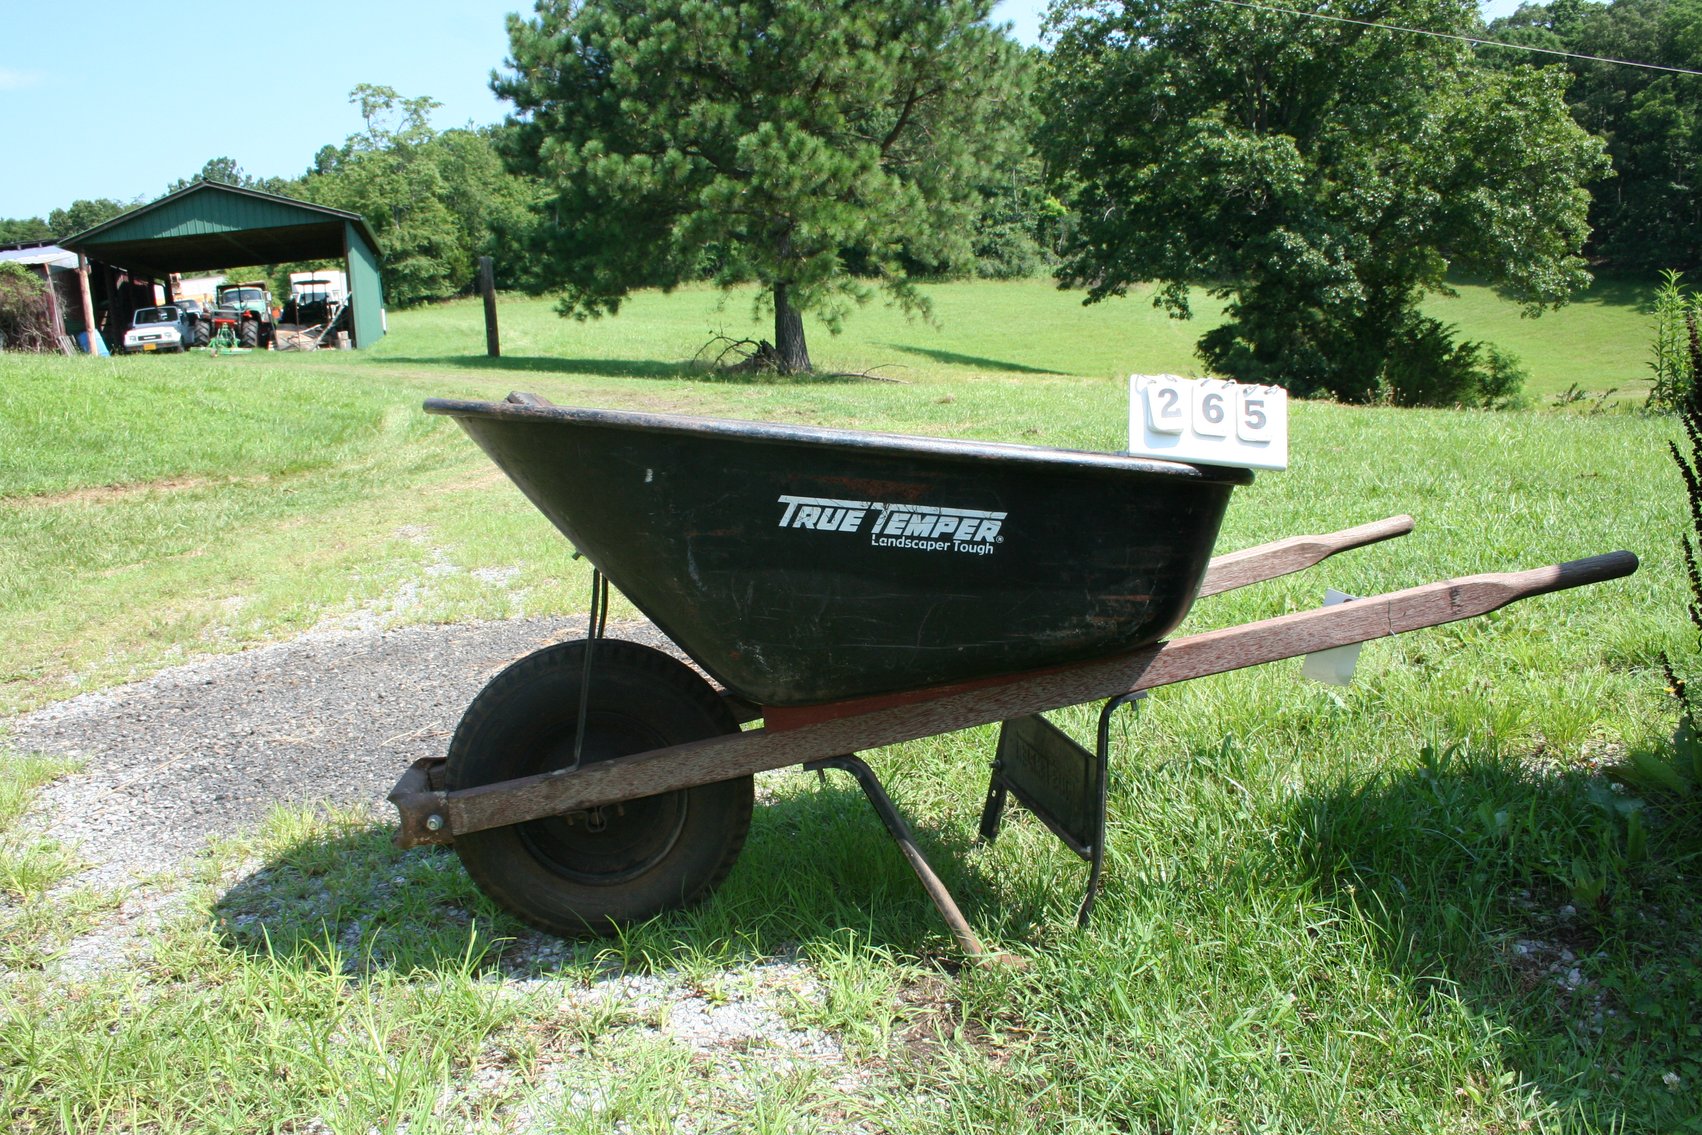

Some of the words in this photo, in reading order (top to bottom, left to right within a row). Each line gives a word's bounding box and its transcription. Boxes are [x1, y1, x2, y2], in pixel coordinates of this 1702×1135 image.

[1157, 388, 1267, 430] 265
[777, 495, 871, 532] TRUE
[871, 502, 1008, 542] TEMPER
[871, 534, 950, 551] Landscaper
[953, 540, 994, 556] Tough
